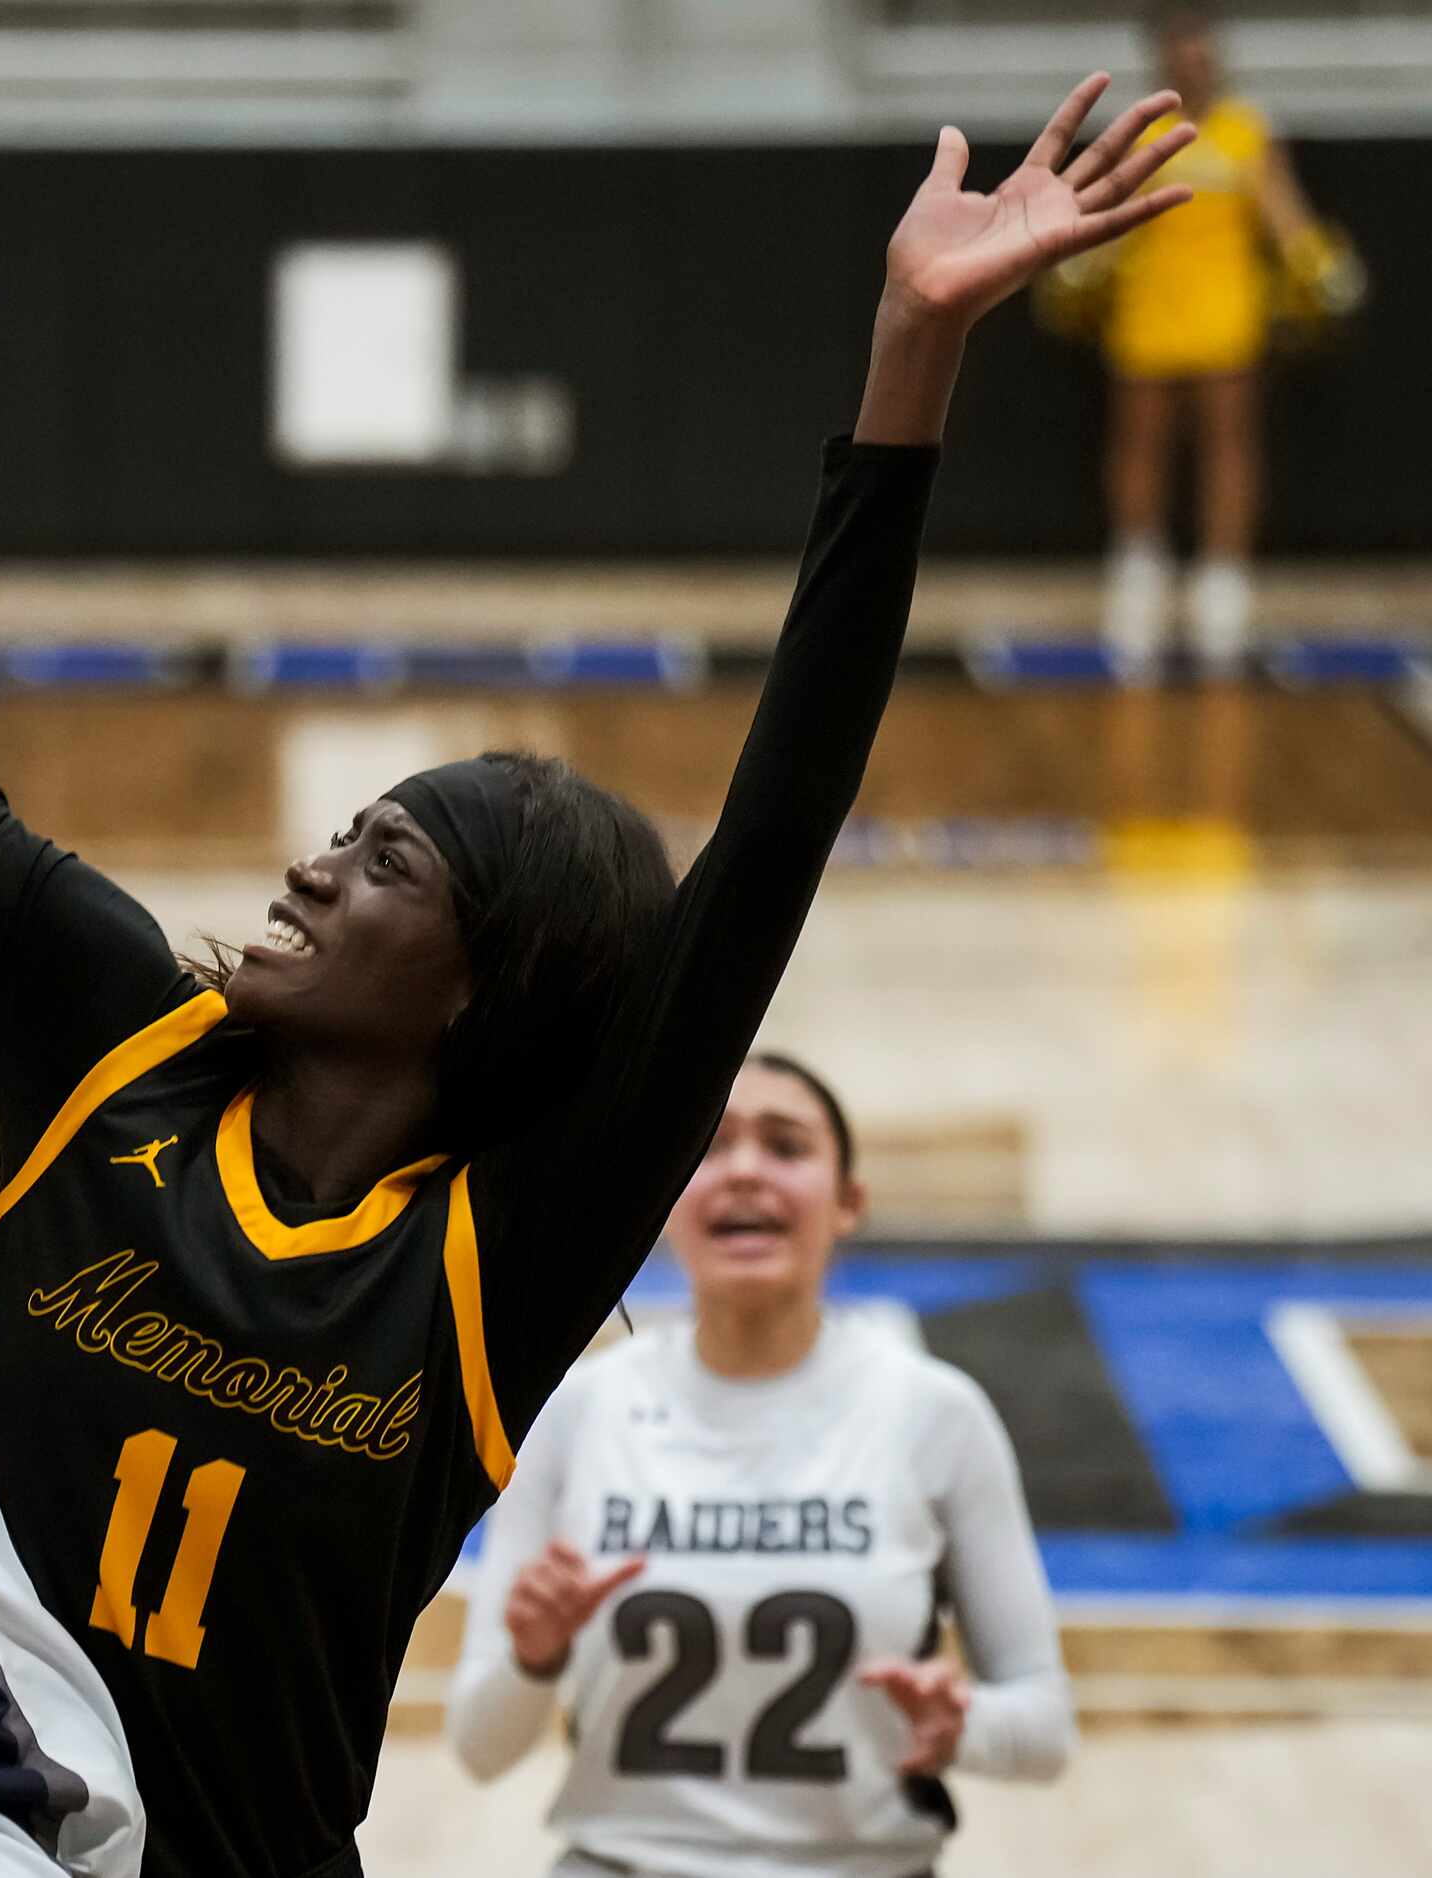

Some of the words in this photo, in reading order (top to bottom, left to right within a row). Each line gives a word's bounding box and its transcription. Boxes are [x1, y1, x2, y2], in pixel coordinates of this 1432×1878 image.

[28, 1249, 423, 1460] Memorial
[89, 1429, 247, 1669] 11
[599, 1495, 873, 1554] RAIDERS
[614, 1590, 856, 1780] 22
